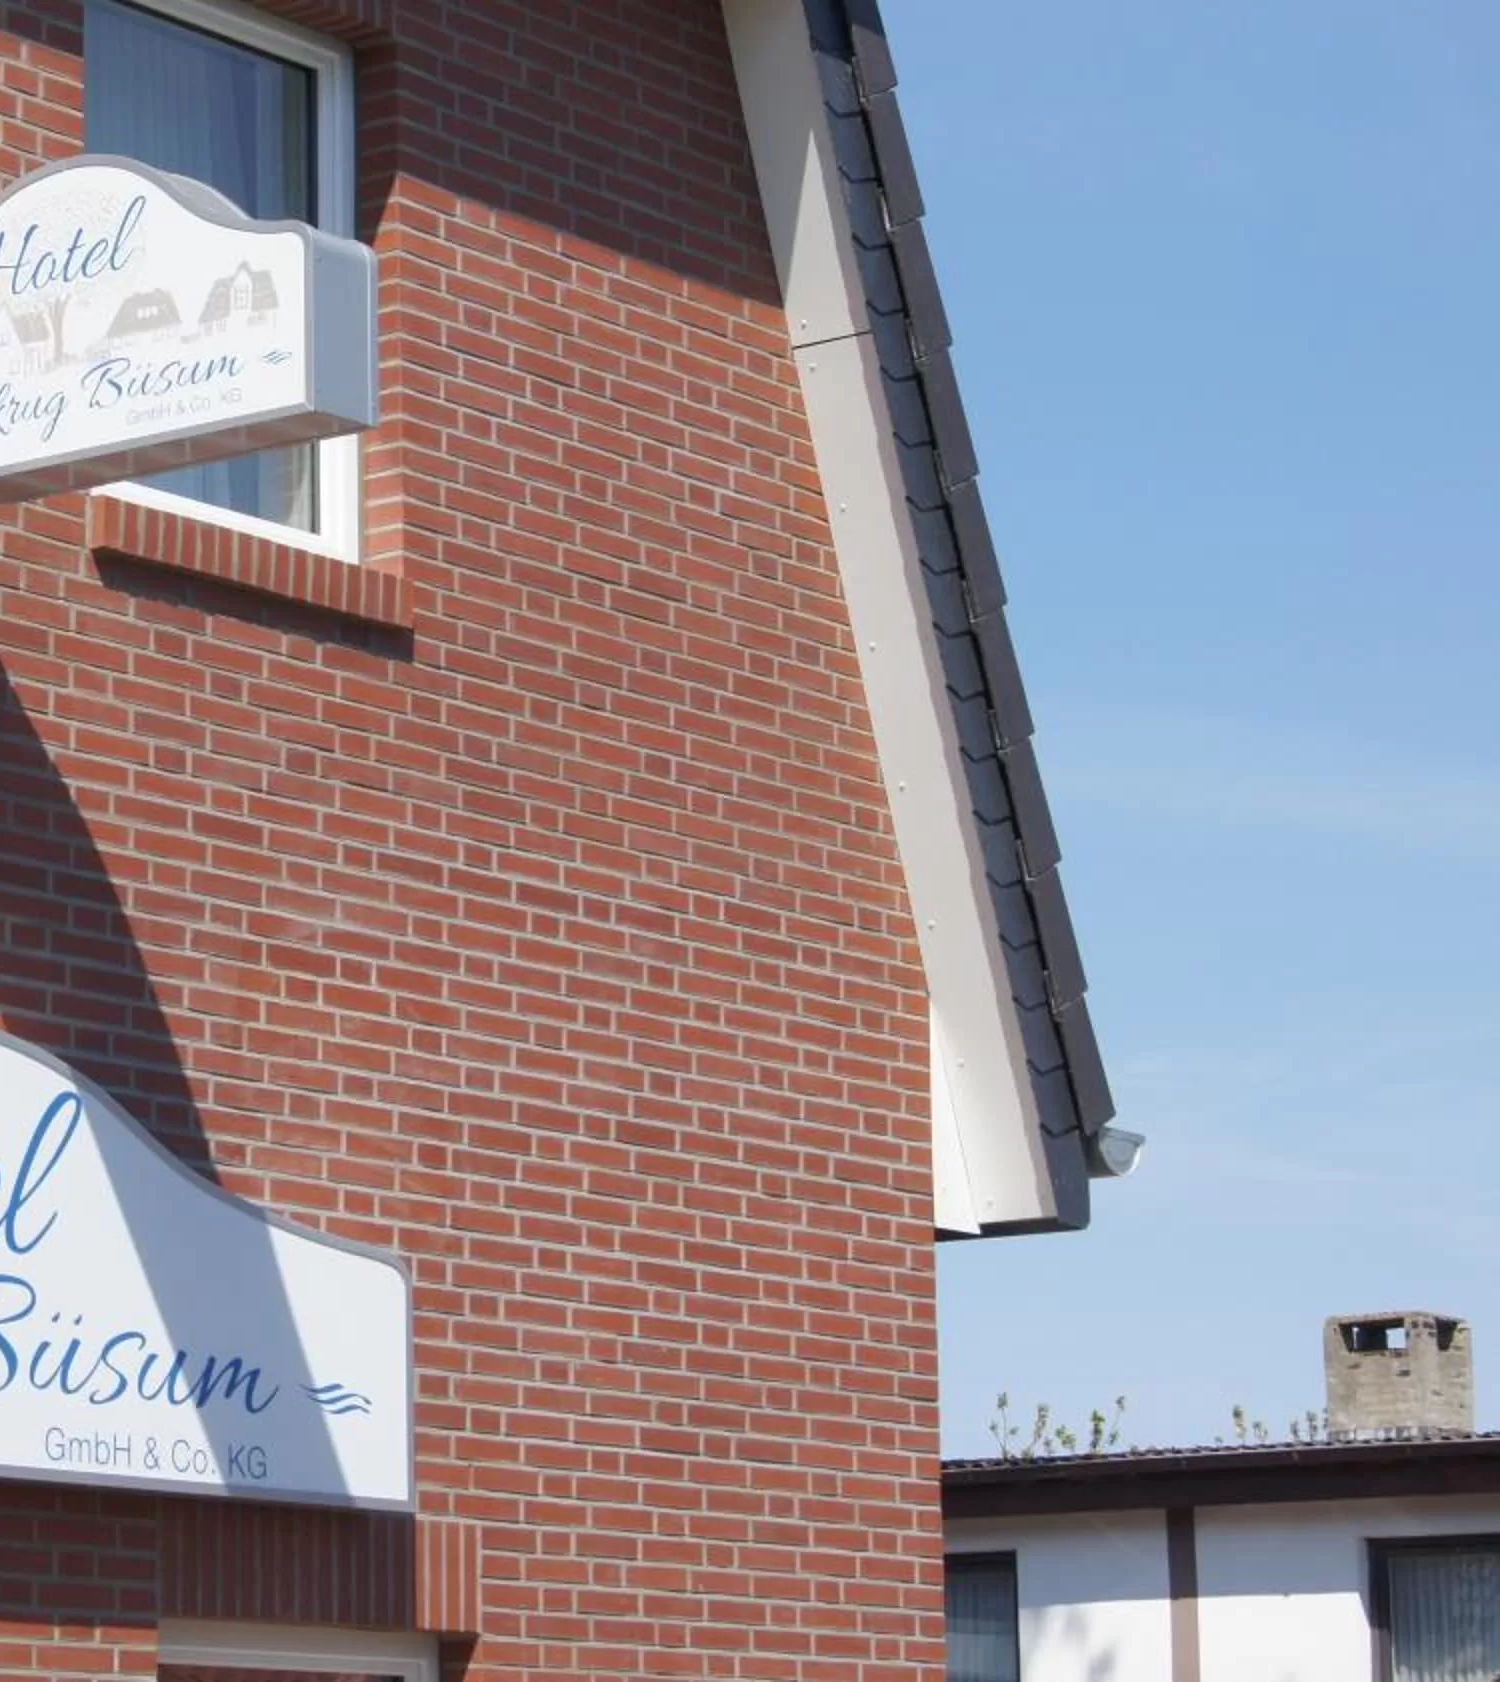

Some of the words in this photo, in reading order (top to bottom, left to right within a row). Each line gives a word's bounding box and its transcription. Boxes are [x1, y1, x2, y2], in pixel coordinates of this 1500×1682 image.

[81, 354, 243, 408] Büsum
[44, 1427, 132, 1468] GmbH
[143, 1437, 161, 1471] &
[171, 1439, 217, 1475] Co.
[228, 1444, 269, 1480] KG
